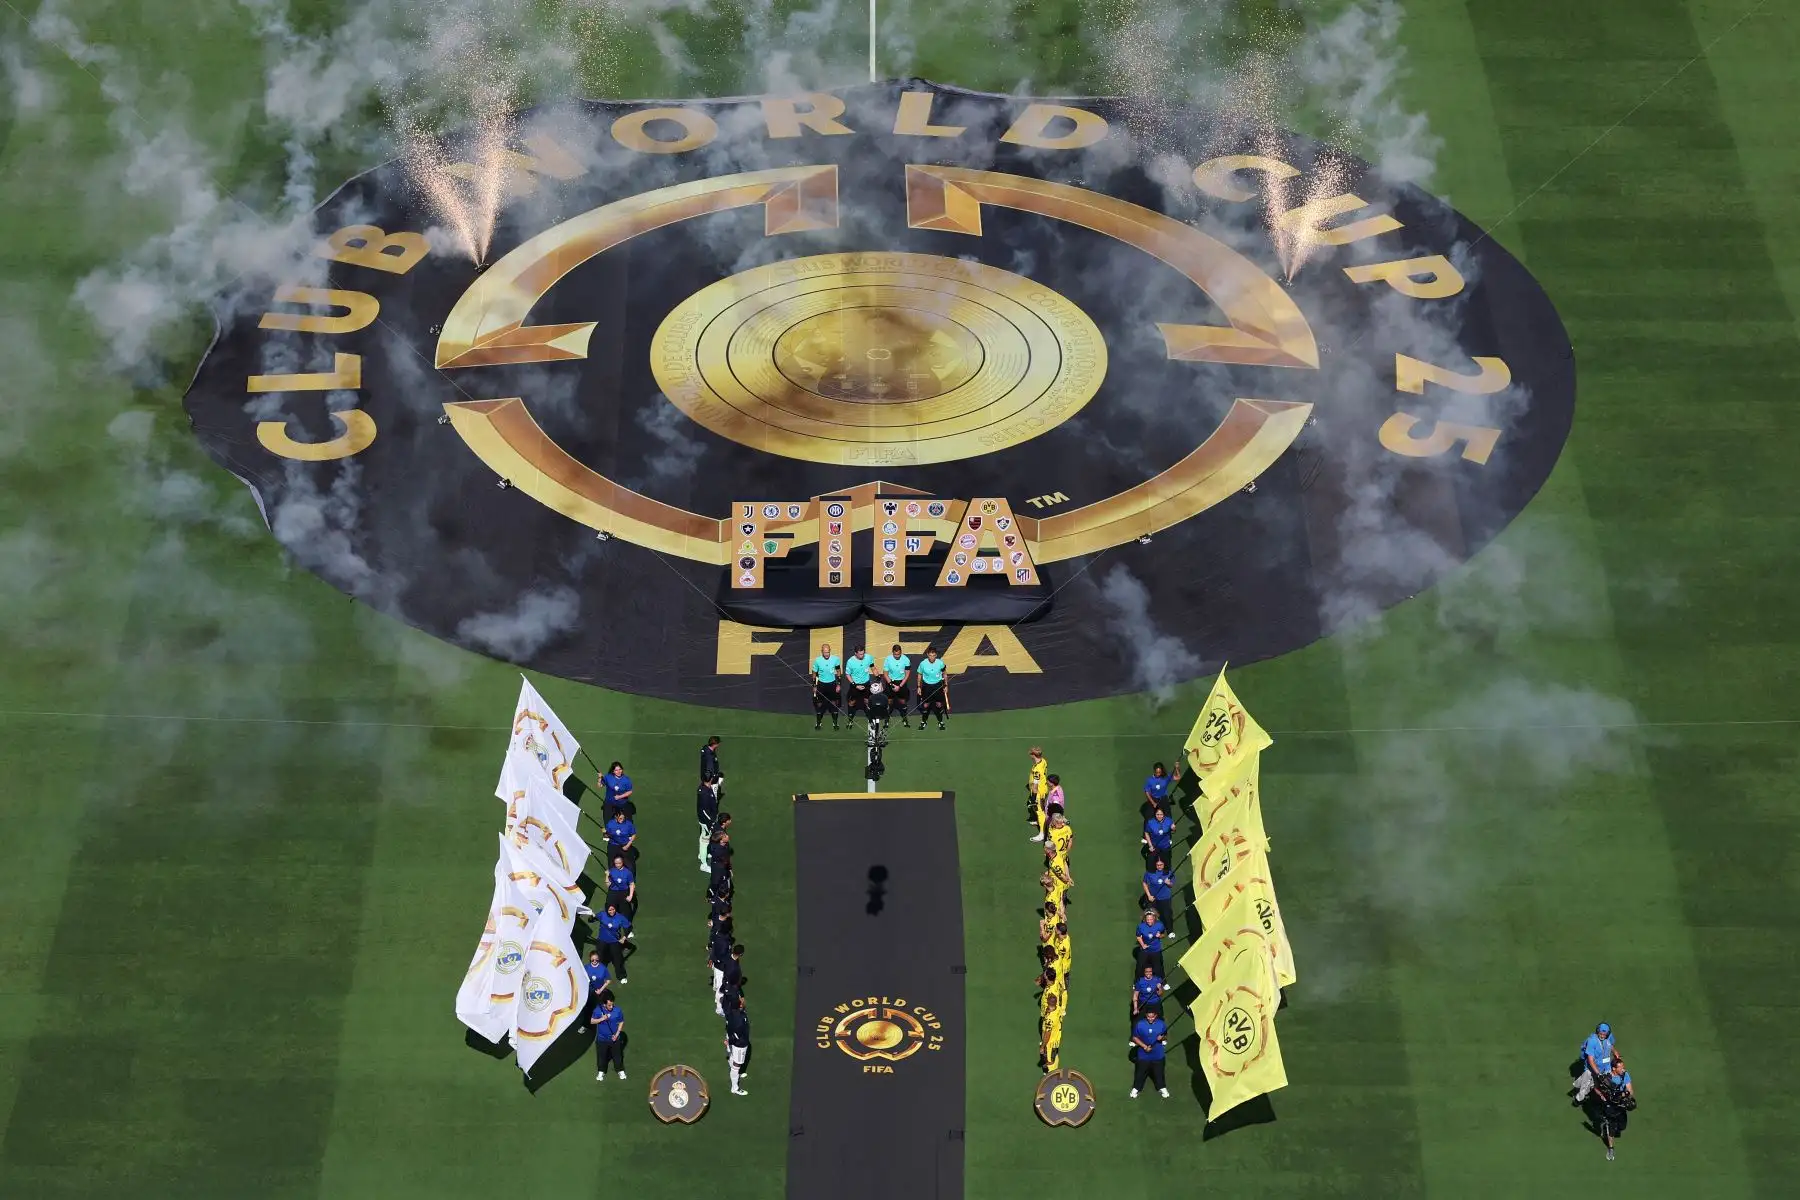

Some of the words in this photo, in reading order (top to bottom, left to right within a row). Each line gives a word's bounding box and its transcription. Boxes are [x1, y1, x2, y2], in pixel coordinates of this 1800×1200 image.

[247, 225, 431, 461] CLUB
[1193, 154, 1465, 299] CUP
[1379, 353, 1512, 465] 25
[1025, 491, 1071, 509] TM
[731, 497, 1042, 589] FIFA
[716, 620, 1043, 675] FIFA
[816, 1016, 835, 1049] CLUB
[834, 996, 907, 1014] WORLD
[913, 1006, 942, 1030] CUP
[928, 1035, 944, 1051] 25
[863, 1065, 894, 1074] FIFA
[1055, 1087, 1076, 1104] BVB
